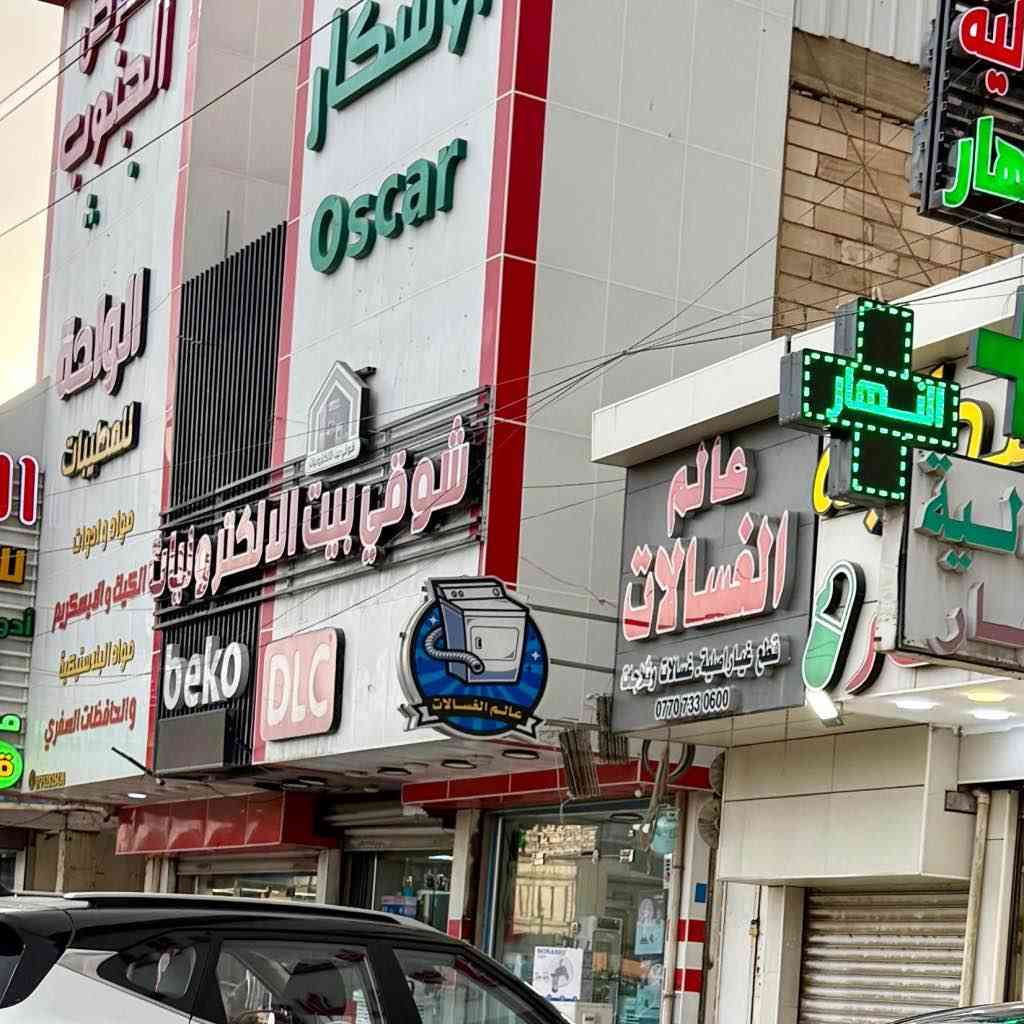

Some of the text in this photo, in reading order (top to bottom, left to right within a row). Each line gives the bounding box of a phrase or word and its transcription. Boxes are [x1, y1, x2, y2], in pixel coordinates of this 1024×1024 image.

[310, 137, 468, 276] Oscar
[56, 267, 151, 401] الواحة
[826, 366, 945, 428] النهار
[301, 479, 357, 562] بيت
[666, 435, 749, 538] عالم
[622, 509, 789, 641] الغسالات
[163, 635, 250, 711] beko
[267, 642, 333, 726] DLC
[489, 704, 523, 719] عالم
[655, 686, 731, 720] 0770 733 0600
